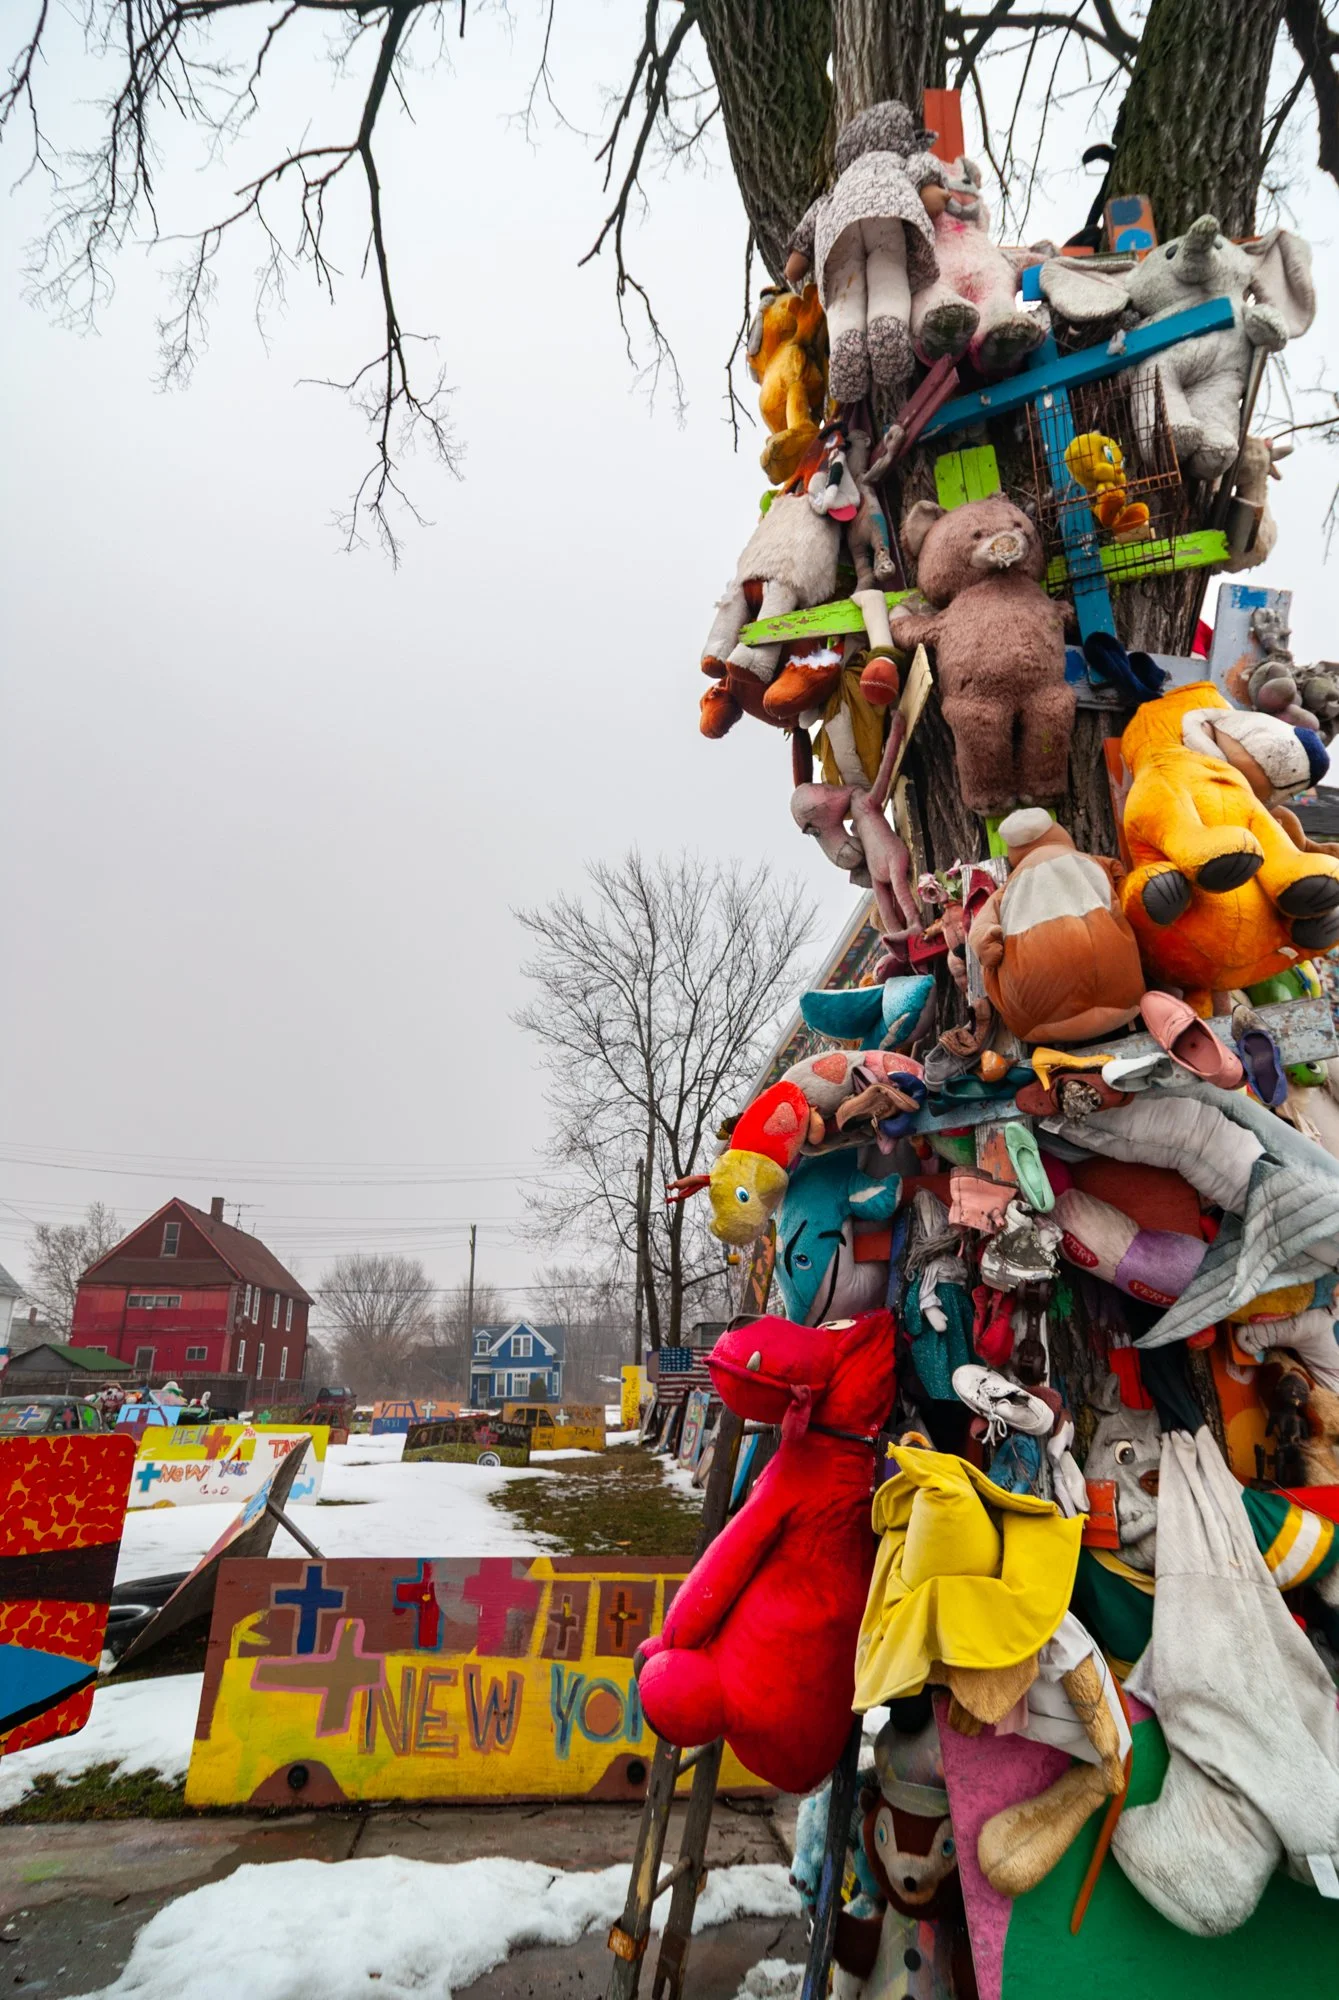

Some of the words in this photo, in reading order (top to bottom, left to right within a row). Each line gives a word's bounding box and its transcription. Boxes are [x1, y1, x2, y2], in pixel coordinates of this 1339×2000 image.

[381, 1418, 400, 1429] TAXI
[358, 1663, 525, 1759] NEW
[551, 1662, 643, 1761] YO
